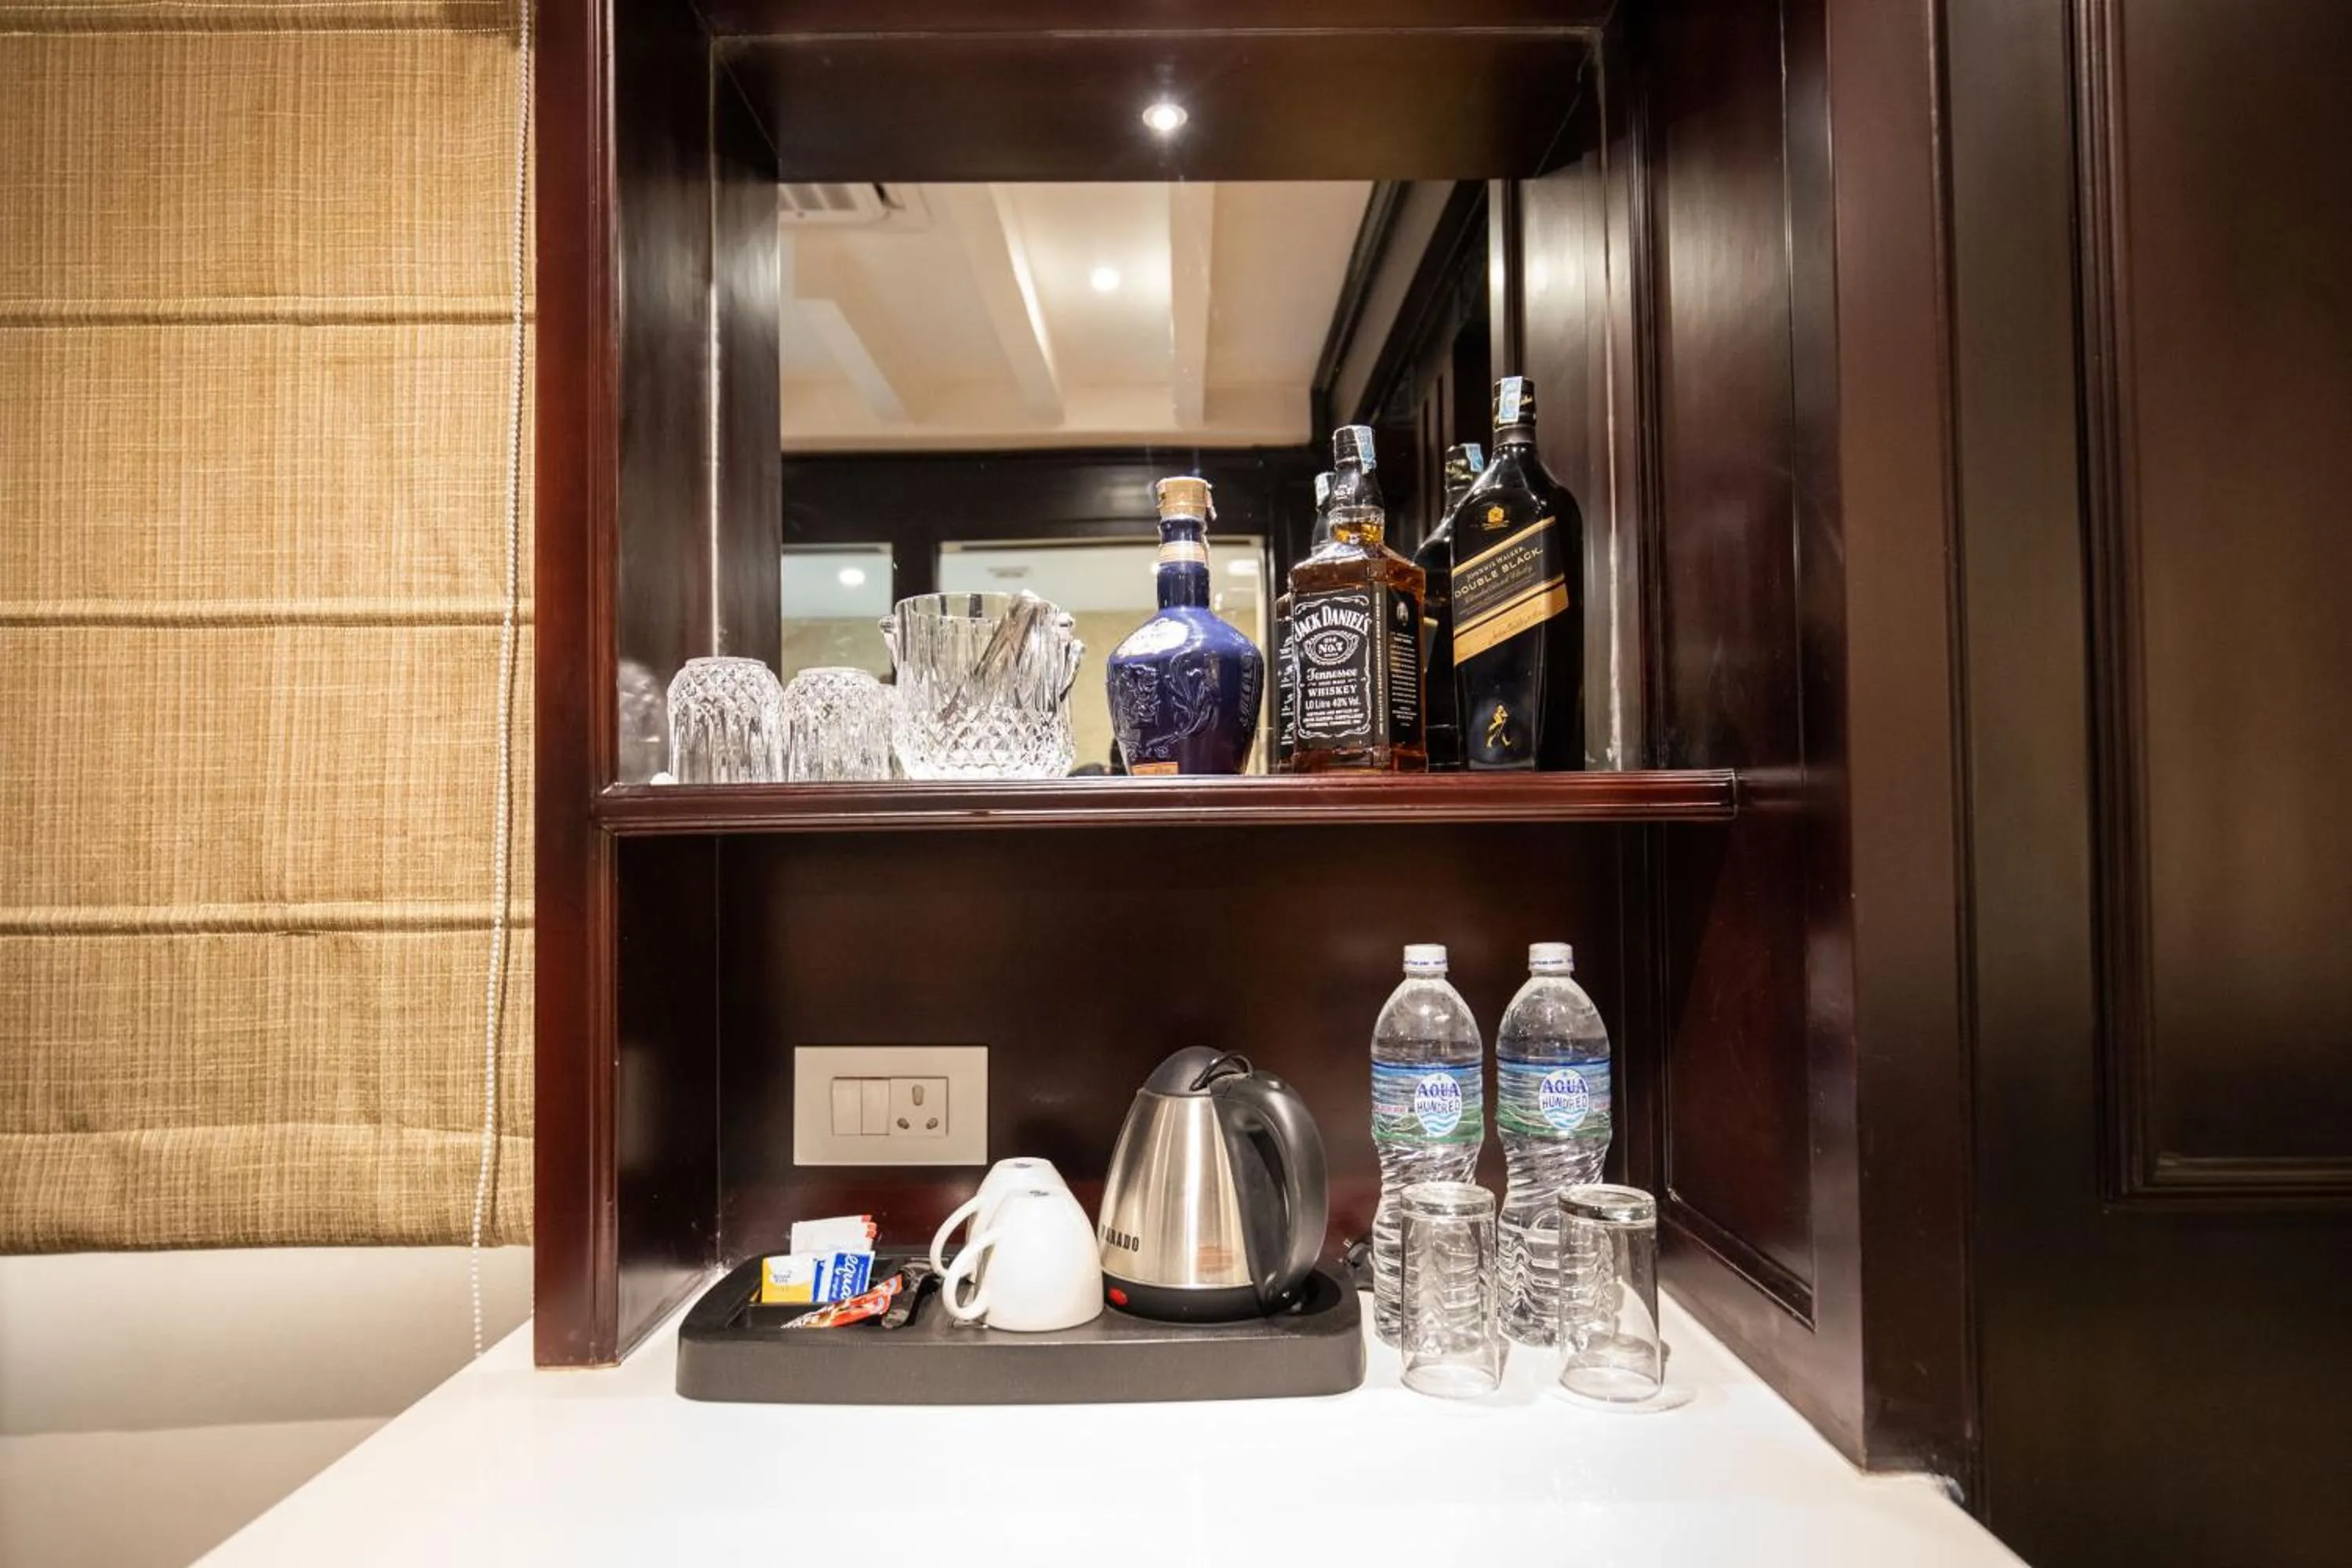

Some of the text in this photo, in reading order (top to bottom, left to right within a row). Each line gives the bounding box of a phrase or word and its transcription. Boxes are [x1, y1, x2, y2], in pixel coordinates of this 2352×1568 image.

[1454, 570, 1498, 598] DOUBLE
[1295, 605, 1372, 641] JACK DANIEL'S
[1308, 684, 1357, 697] WHISKEY
[1417, 1082, 1461, 1098] AQUA
[1542, 1079, 1587, 1094] AQUA
[1417, 1099, 1460, 1113] HUNDRED
[1542, 1095, 1587, 1110] HUNDRED
[836, 1254, 859, 1299] equa
